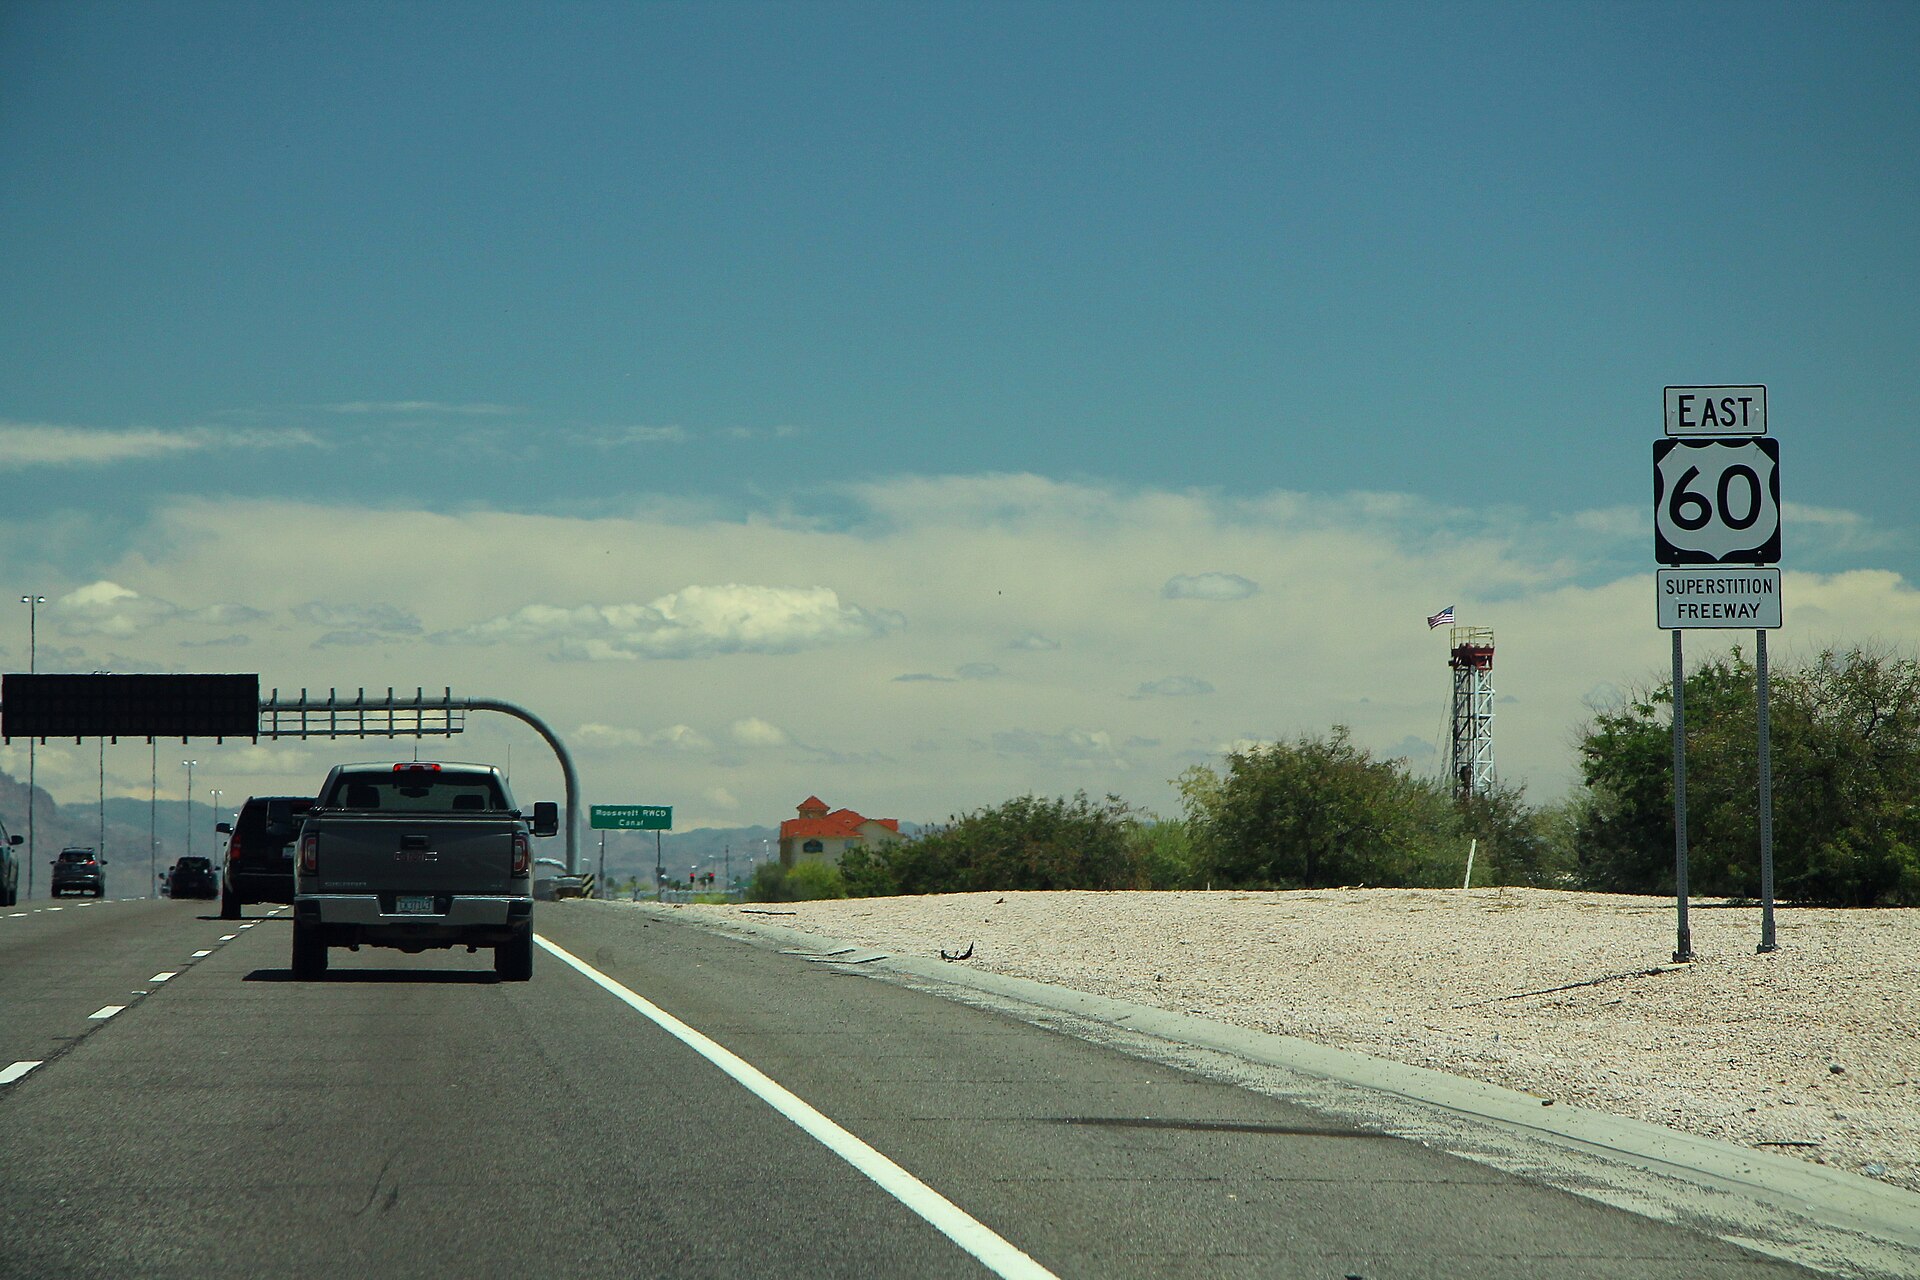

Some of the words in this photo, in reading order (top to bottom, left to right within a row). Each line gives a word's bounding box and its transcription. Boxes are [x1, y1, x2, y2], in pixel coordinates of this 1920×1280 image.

[1678, 394, 1753, 428] EAST
[1668, 463, 1762, 531] 60
[1665, 578, 1773, 595] SUPERSTITION
[1677, 602, 1761, 619] FREEWAY
[595, 809, 639, 817] Roosevelt
